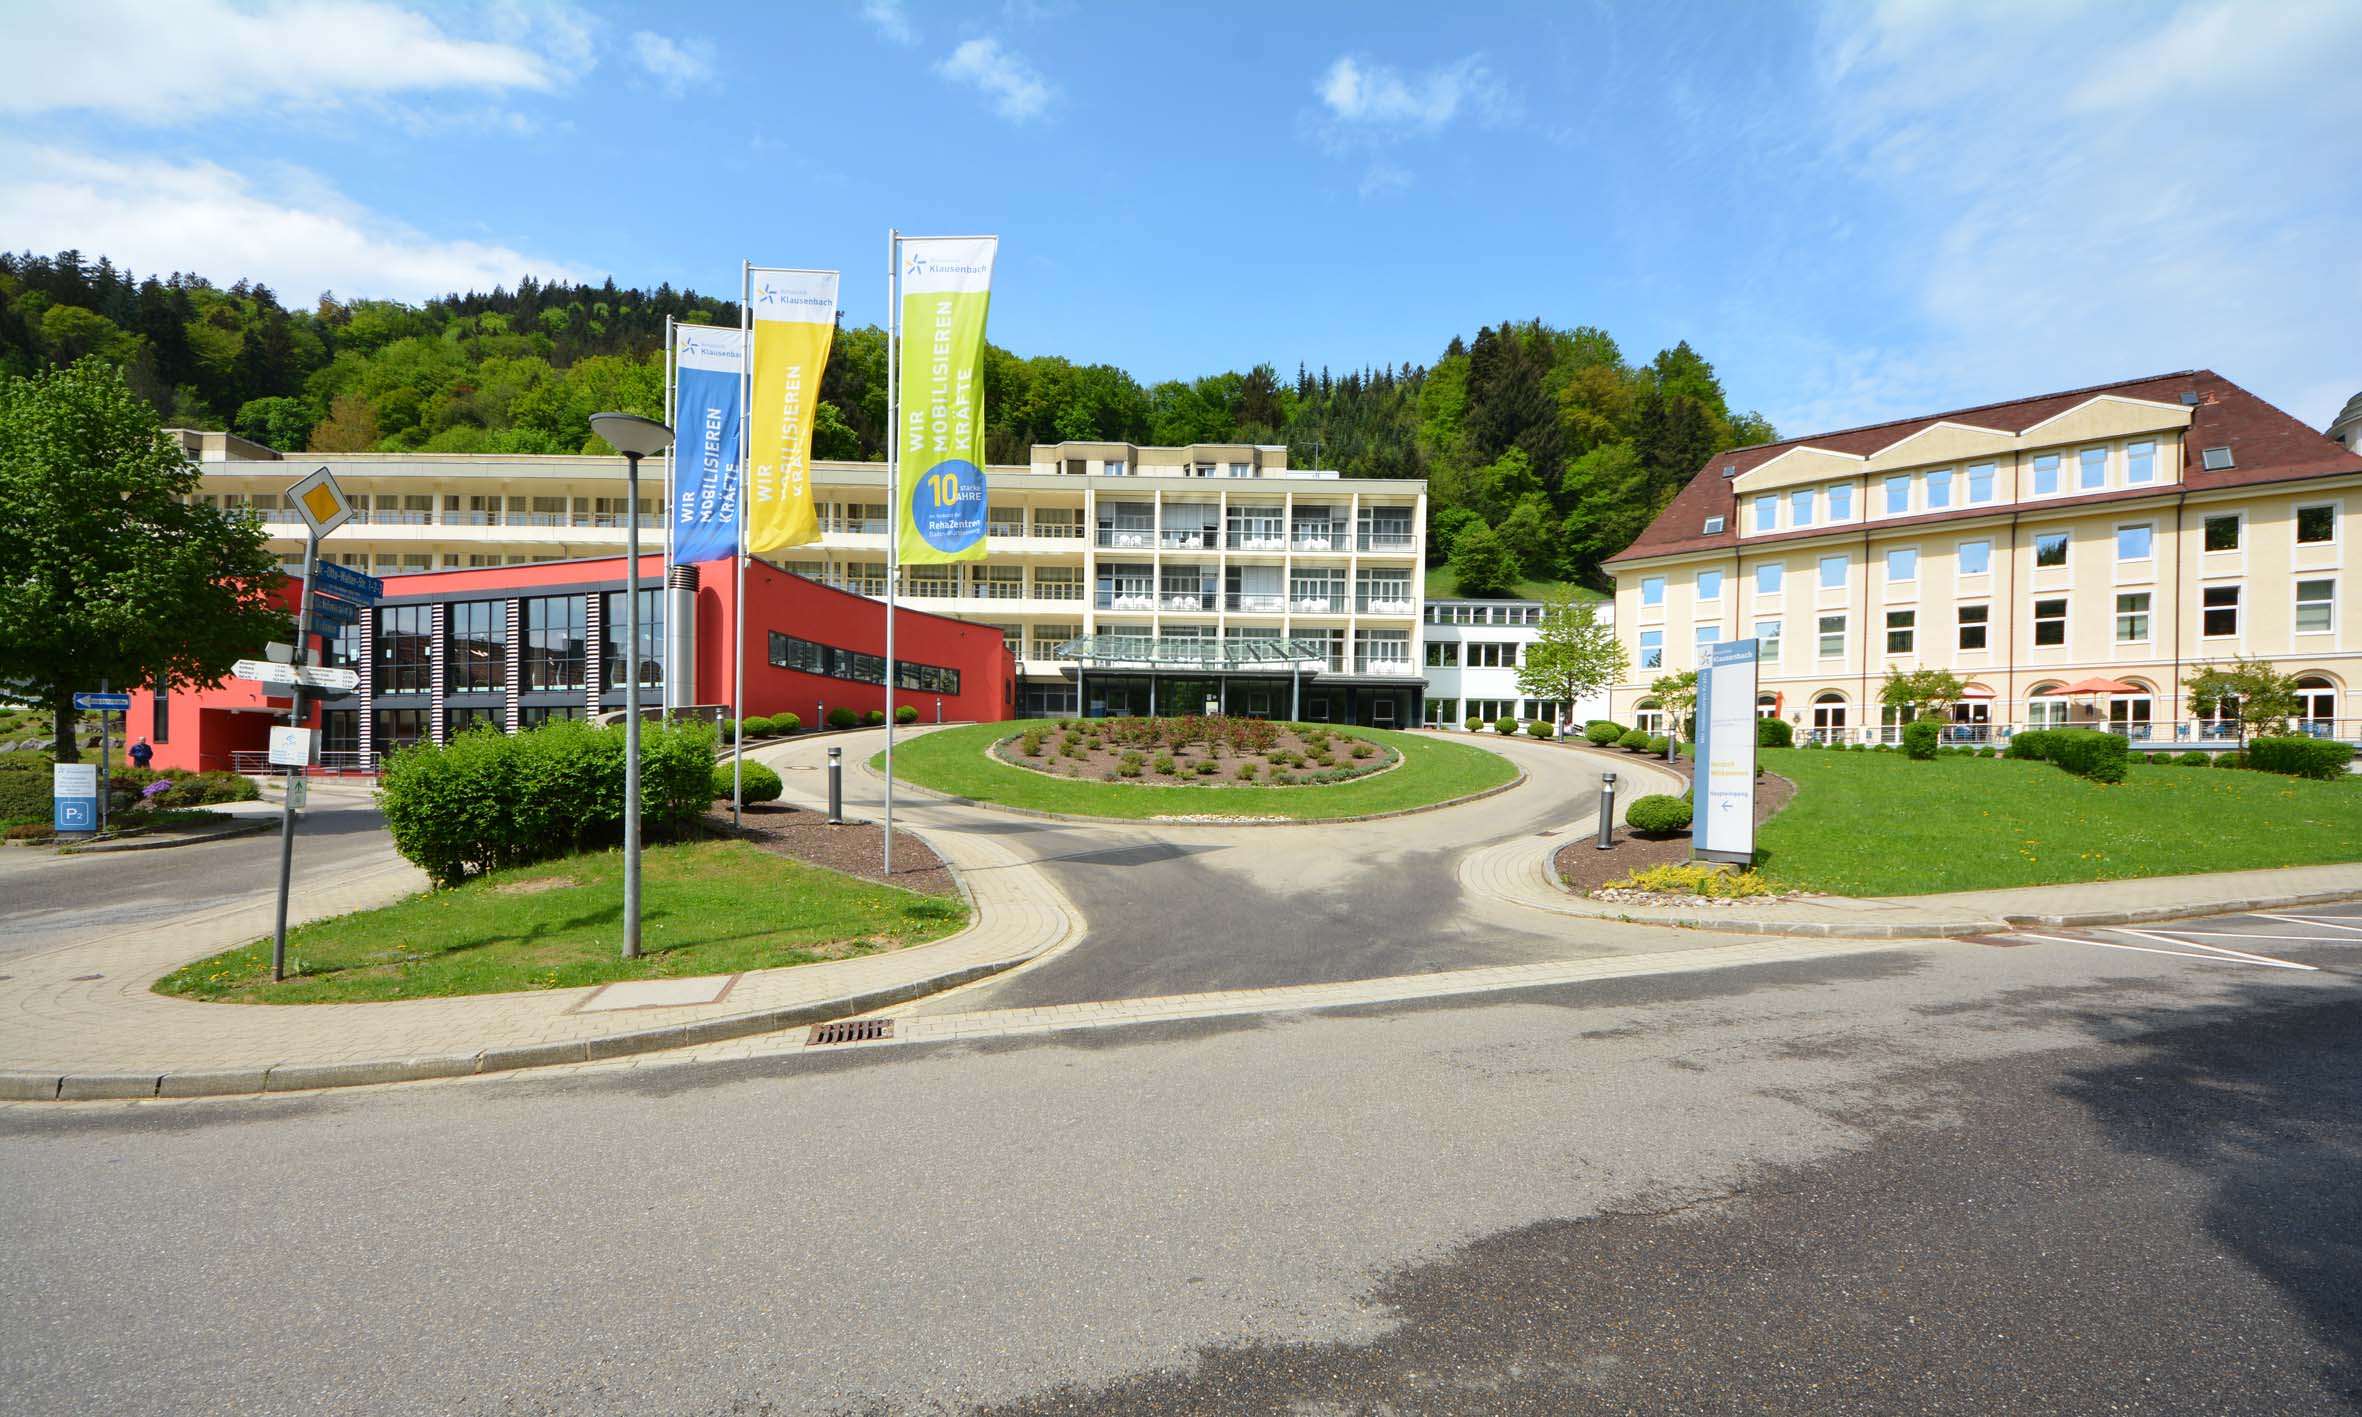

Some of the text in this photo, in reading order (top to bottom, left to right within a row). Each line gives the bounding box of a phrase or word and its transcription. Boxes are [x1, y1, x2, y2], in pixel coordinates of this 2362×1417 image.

[929, 264, 987, 274] Klausenbach
[780, 294, 833, 307] Klausenbach
[931, 301, 953, 452] MOBILISIEREN
[952, 368, 972, 450] KRÄFTE
[909, 411, 925, 453] WIR
[699, 407, 722, 523] MOBILISIEREN
[757, 465, 773, 503] WIR
[681, 491, 695, 524] WIR
[719, 463, 739, 523] KRÄFTE
[927, 472, 959, 507] 10
[955, 492, 982, 501] AHRE
